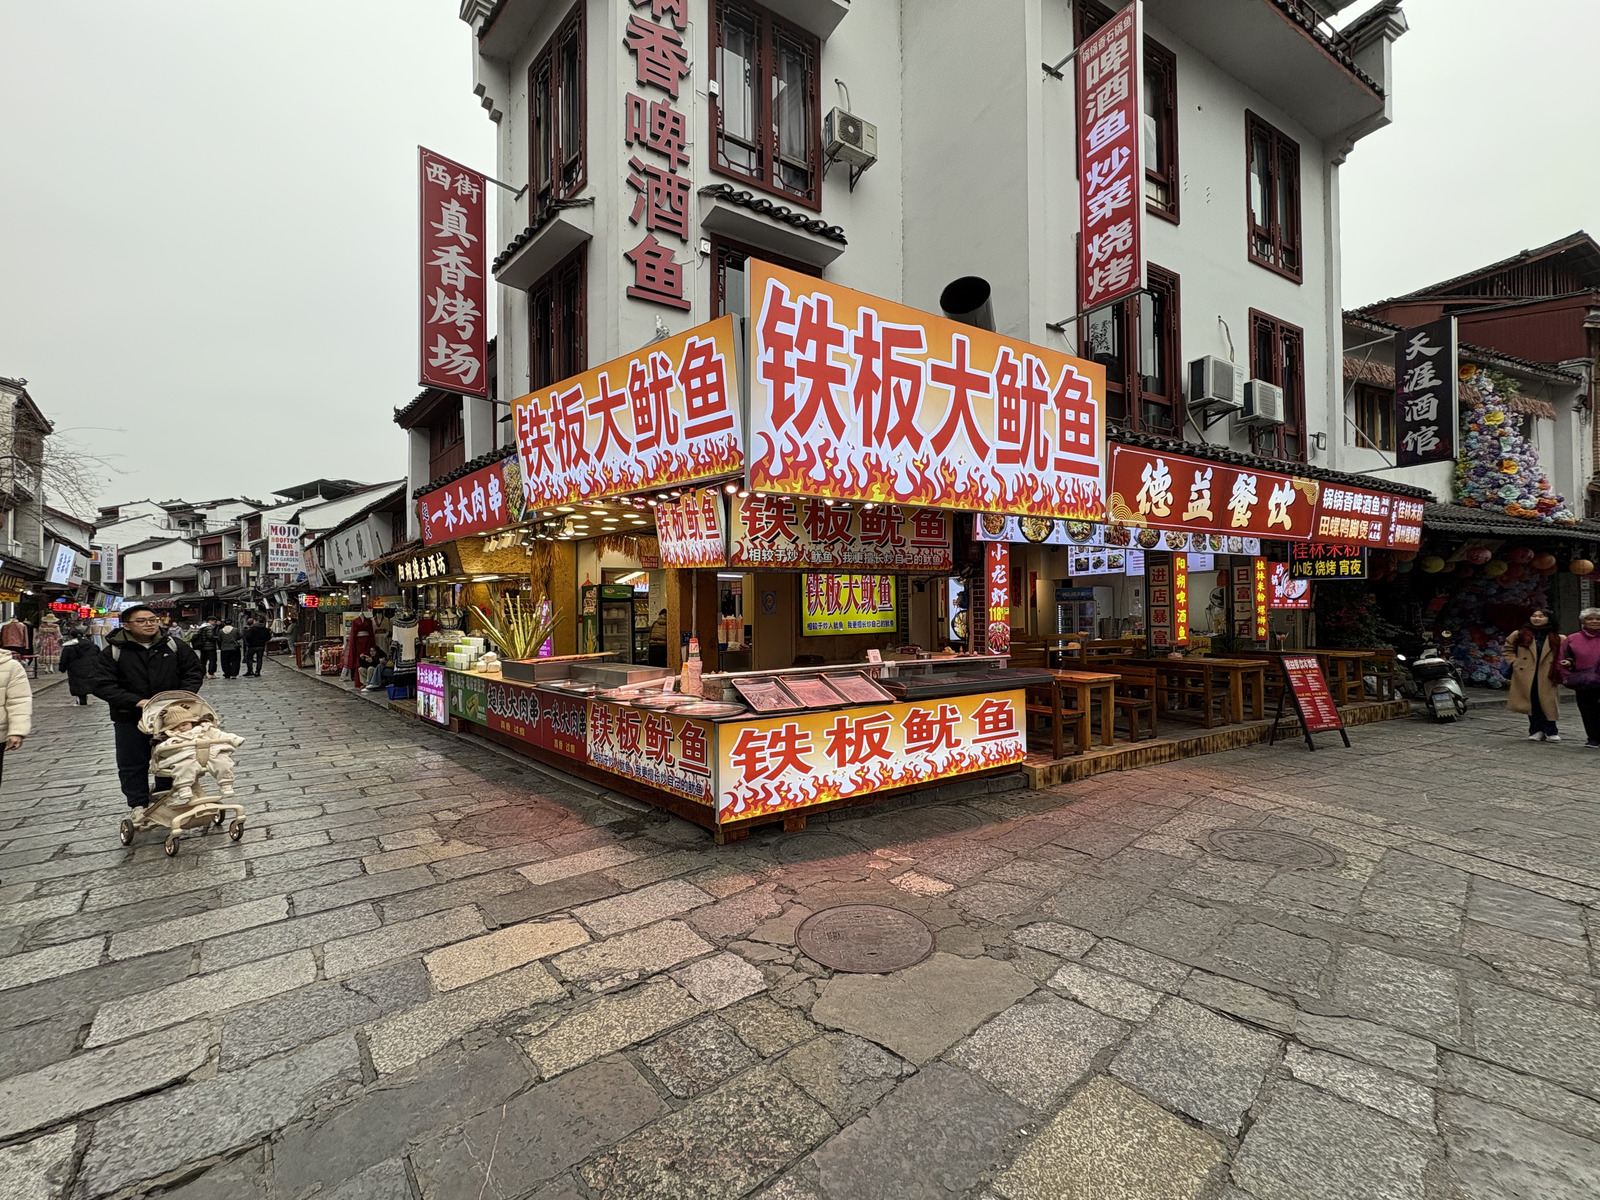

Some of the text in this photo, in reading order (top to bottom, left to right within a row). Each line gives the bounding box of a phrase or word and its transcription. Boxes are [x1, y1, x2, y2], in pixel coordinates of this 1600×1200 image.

[426, 161, 481, 205] 西街
[427, 197, 482, 385] 真香烤场
[760, 280, 1101, 479] 铁板大鱿鱼
[1403, 332, 1444, 456] 天涯酒馆
[517, 337, 735, 480] 铁板大鱿鱼
[431, 473, 502, 533] 一米大肉串
[656, 495, 720, 542] 铁板鱿鱼
[1136, 459, 1296, 531] 德益餐饮
[1323, 488, 1380, 516] 锅锅香啤酒鱼
[1398, 500, 1423, 521] 桂林米粉
[270, 525, 299, 537] MOJO
[740, 495, 950, 548] 铁板鱿鱼
[1319, 516, 1369, 540] 田螺鸭脚煲
[398, 552, 446, 582] 阳朔德益酒坊
[749, 548, 942, 565] 相较于炒人鱿鱼 我更擅长炒自己的鱿鱼
[992, 543, 1009, 607] 小龙虾
[1293, 559, 1362, 577] 小吃 烧烤 宵夜
[805, 573, 894, 616] 铁板大鱿鱼
[1152, 568, 1168, 645] 进店暴富
[1176, 557, 1187, 641] 阳朔啤酒鱼
[1256, 560, 1267, 637] 桂林米粉 螺蛳粉
[807, 620, 894, 631] 相较于炒人鱿鱼 我更擅长炒自己的鱿鱼
[543, 699, 587, 742] 一米大肉串
[589, 702, 711, 778] 铁板鱿鱼
[732, 699, 1019, 784] 铁板鱿鱼
[635, 765, 703, 797] 我更擅长炒自己的鱿鱼
